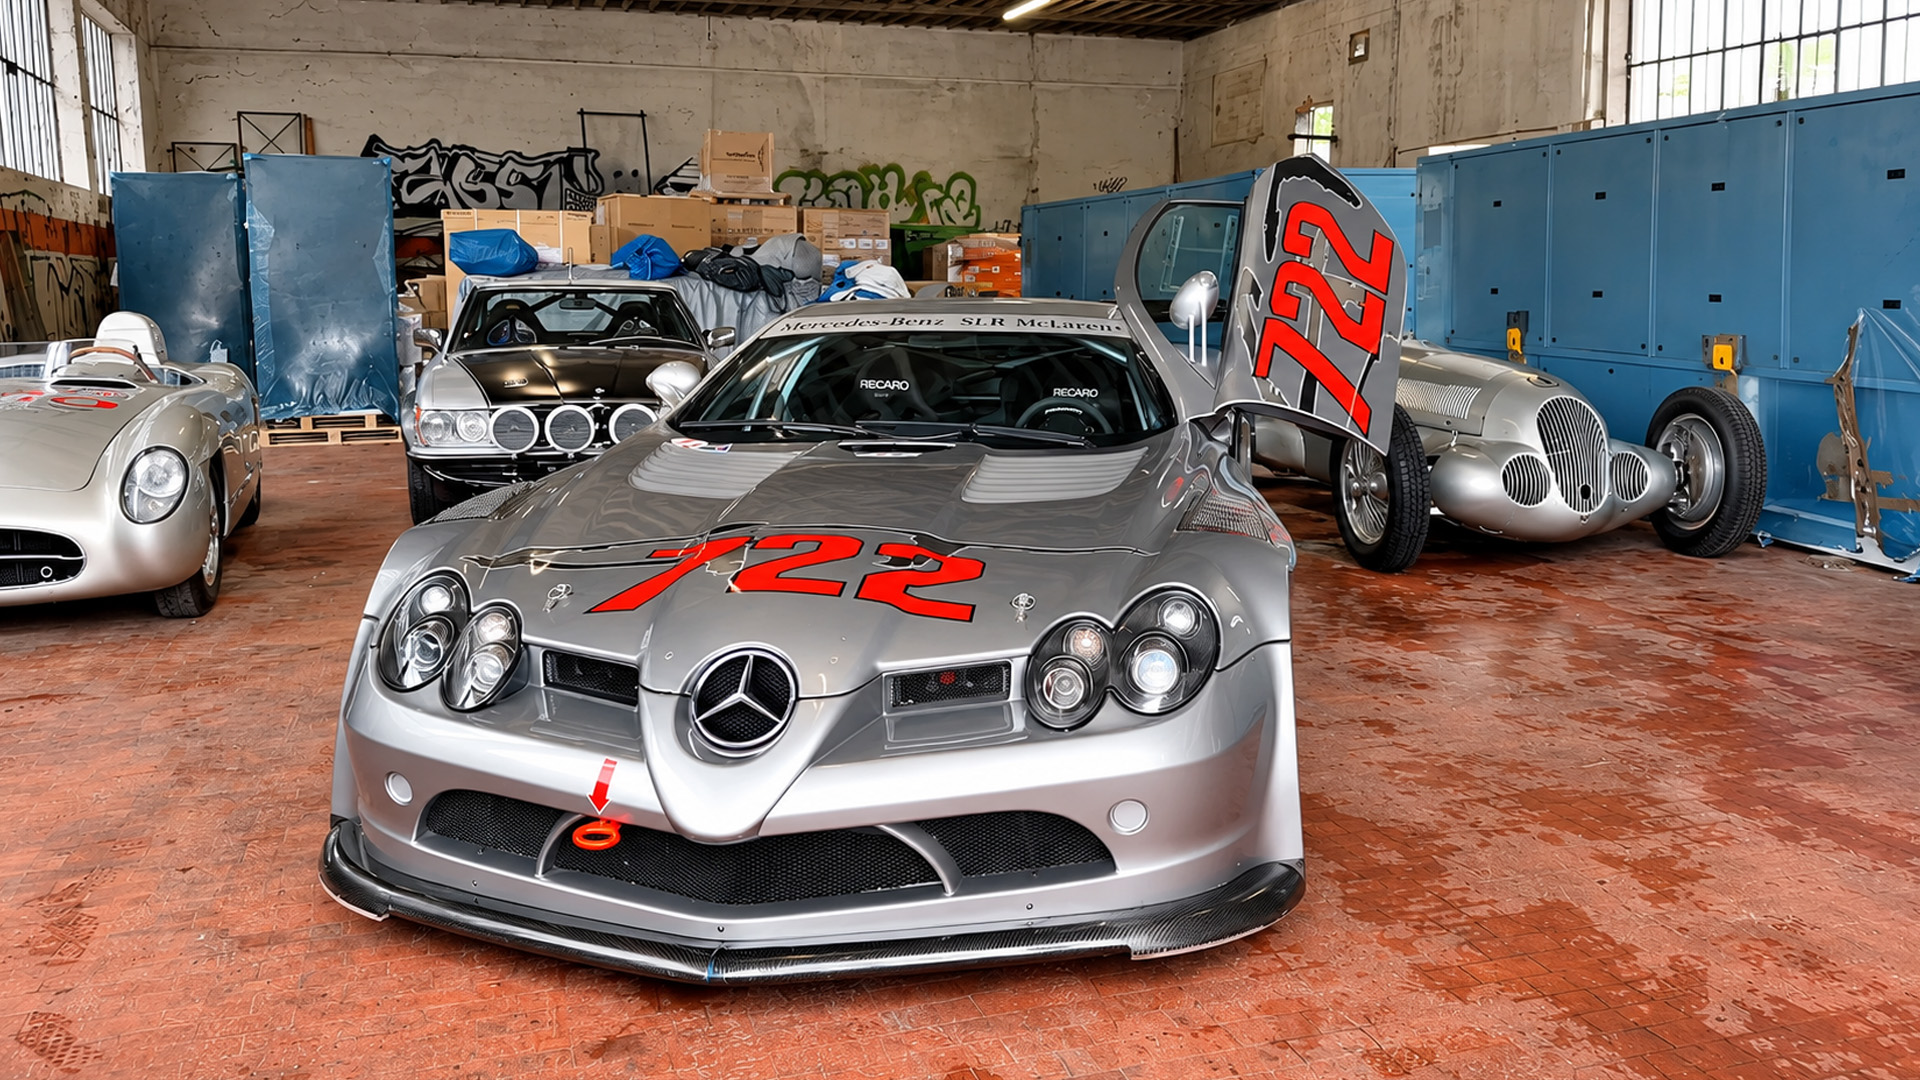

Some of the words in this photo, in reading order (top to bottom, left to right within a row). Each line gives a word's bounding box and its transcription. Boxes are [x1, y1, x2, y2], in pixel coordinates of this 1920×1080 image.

[780, 316, 945, 332] Mercedes-Benz
[959, 316, 1006, 327] SLR
[1252, 201, 1395, 436] 722
[859, 378, 910, 392] RECARO
[1052, 387, 1099, 399] RECARO
[583, 533, 987, 623] 722
